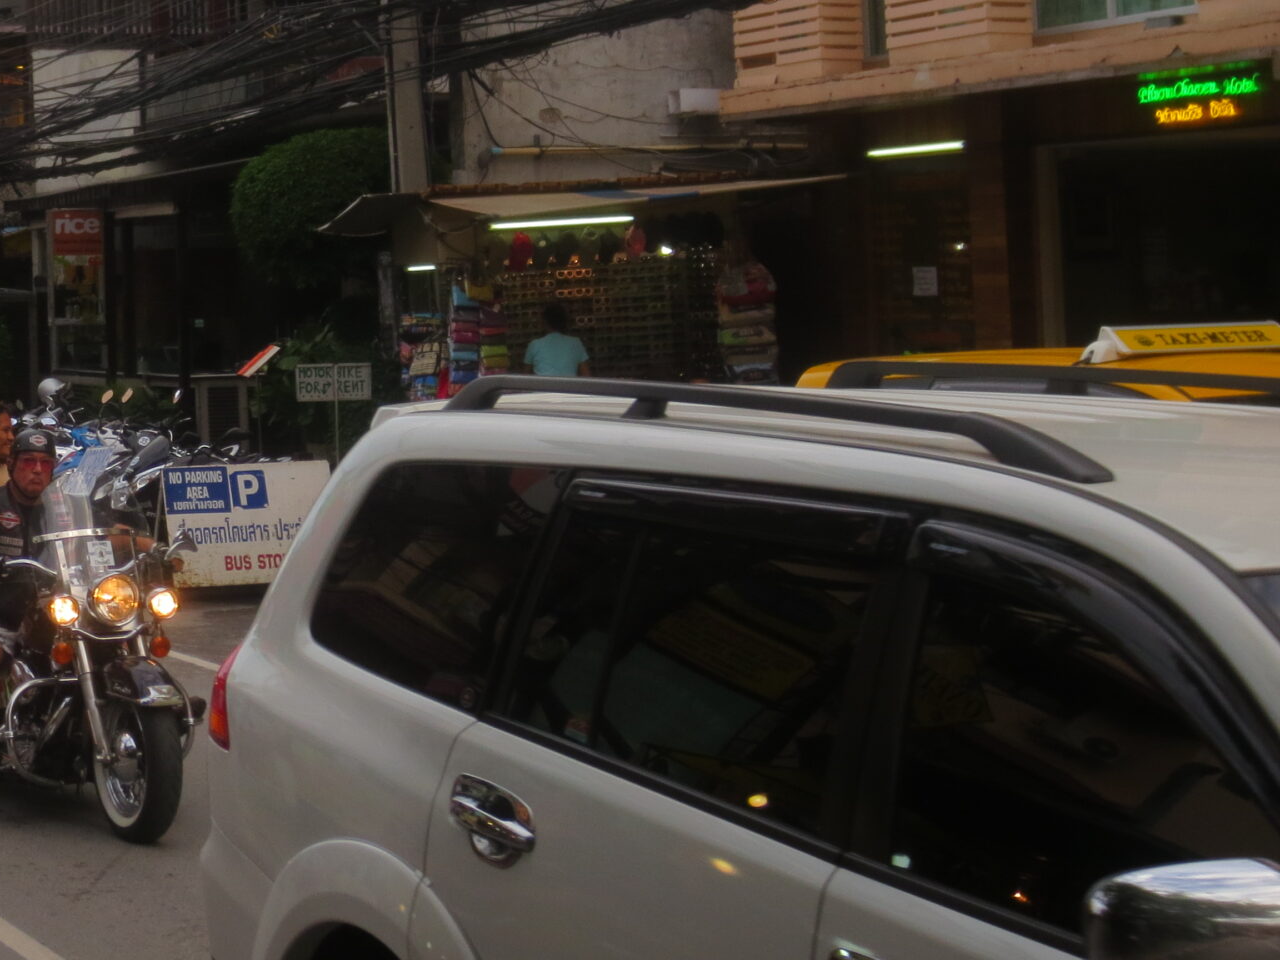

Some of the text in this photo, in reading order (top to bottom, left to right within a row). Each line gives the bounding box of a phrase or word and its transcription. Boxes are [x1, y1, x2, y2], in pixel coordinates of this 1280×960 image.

[55, 213, 100, 234] rice
[1154, 329, 1273, 346] TAXI-METER
[298, 366, 333, 378] MOTOR
[298, 380, 320, 395] FOR
[169, 470, 223, 485] NO PARKING
[186, 486, 210, 499] AREA
[236, 473, 260, 507] P
[224, 553, 286, 571] BUS STO
